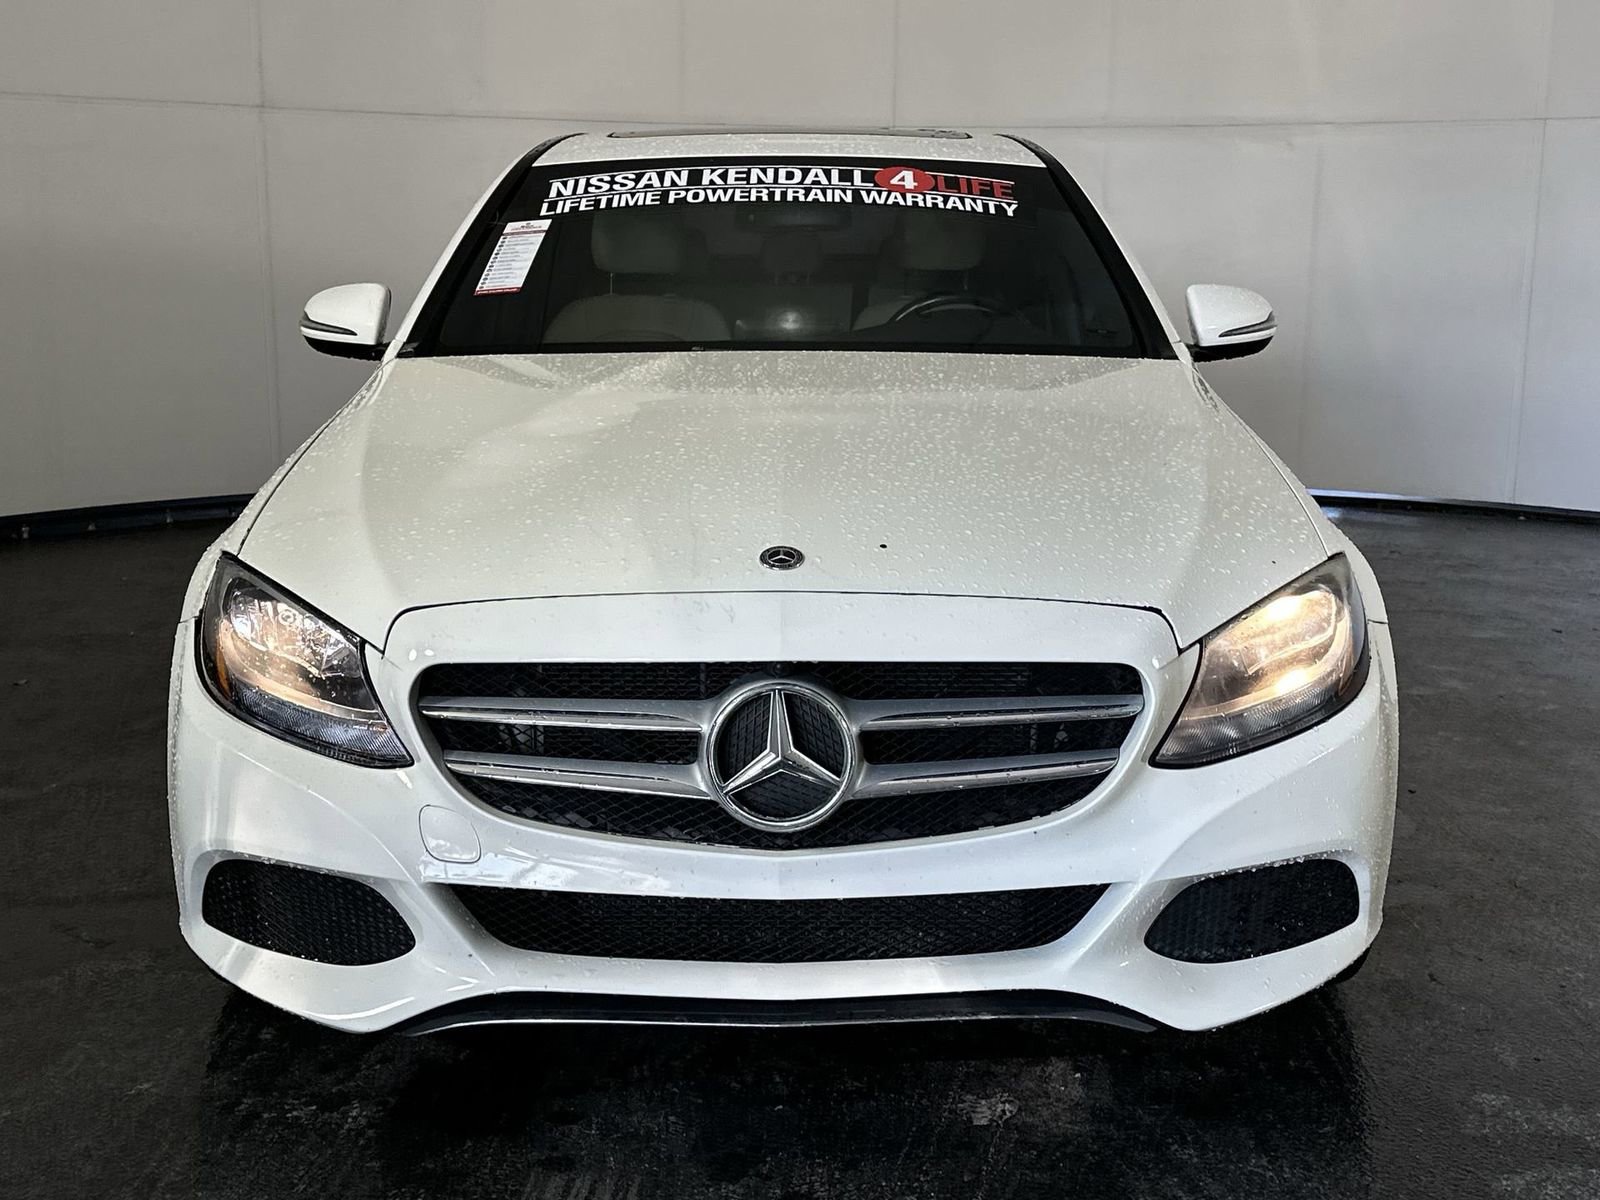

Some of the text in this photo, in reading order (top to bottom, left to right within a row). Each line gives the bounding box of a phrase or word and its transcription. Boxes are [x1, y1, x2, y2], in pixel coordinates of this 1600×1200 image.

[548, 167, 1014, 200] NISSAN KENDALL 4 LIFE
[539, 188, 1019, 217] LIFETIME POWERTRAIN WARRANTY
